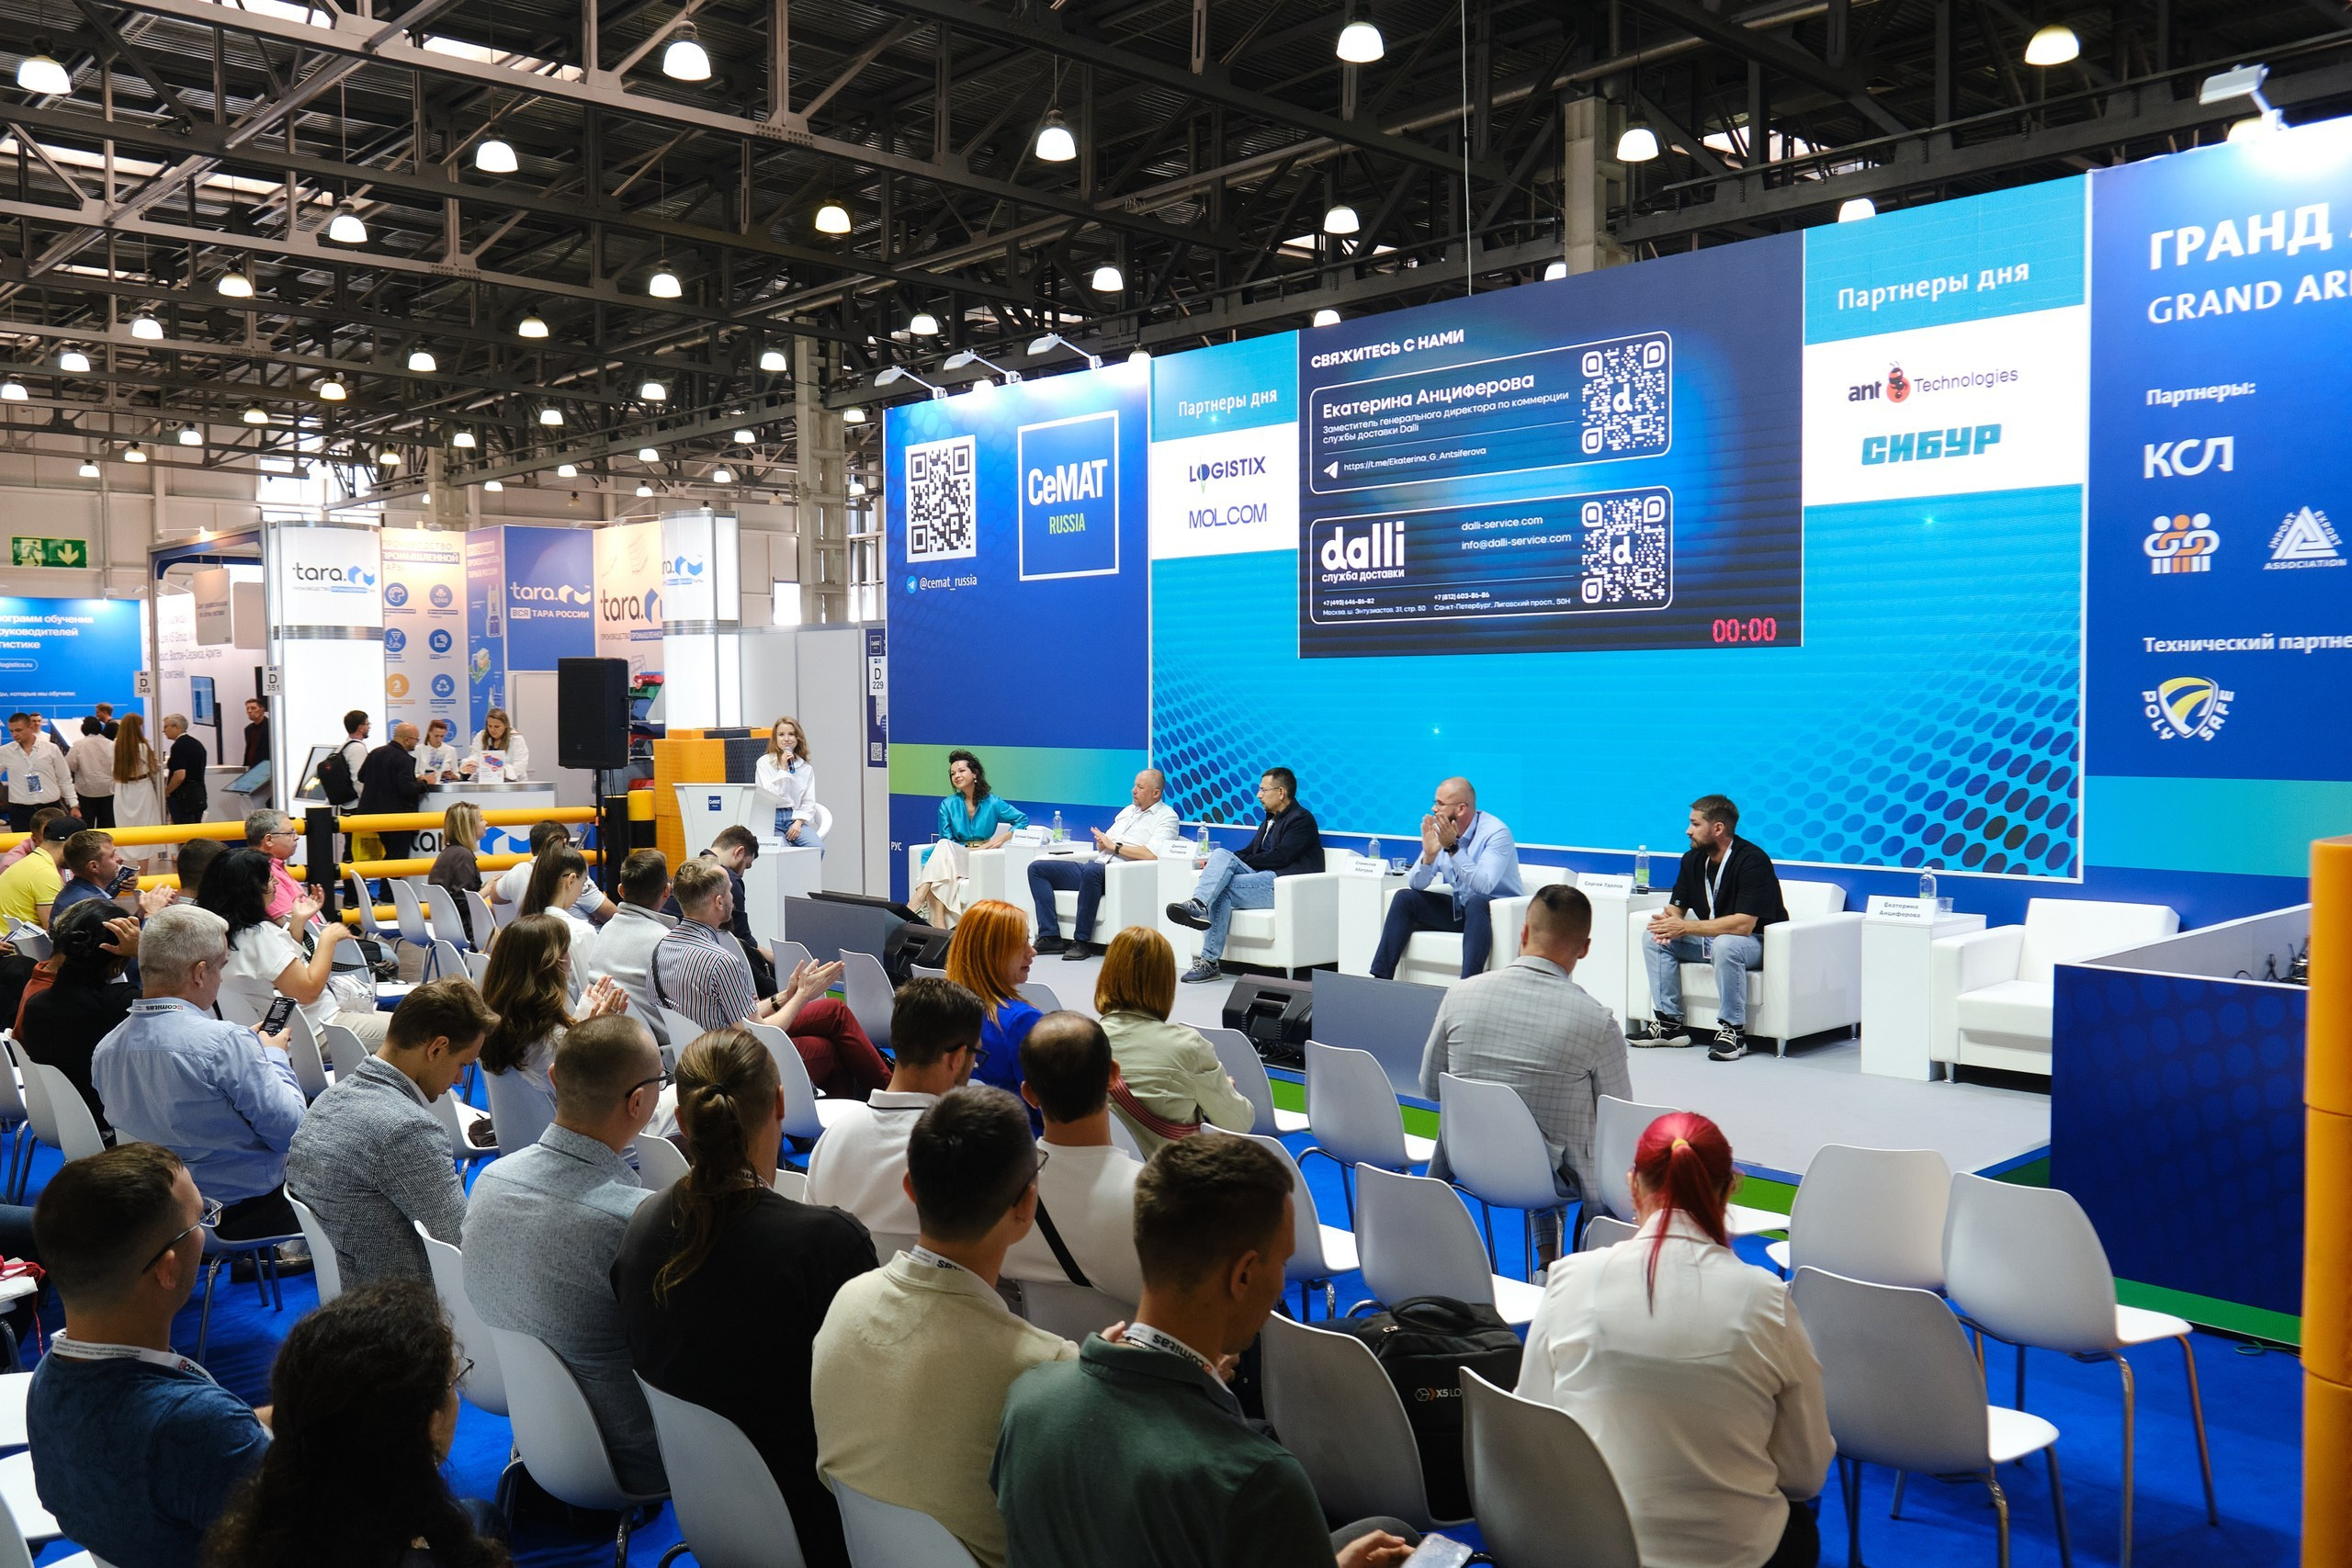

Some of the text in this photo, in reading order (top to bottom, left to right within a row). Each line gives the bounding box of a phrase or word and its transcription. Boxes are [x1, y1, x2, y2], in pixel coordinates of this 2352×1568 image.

[2150, 201, 2334, 270] ГРАНД
[1838, 263, 2030, 311] Партнеры дня
[2148, 270, 2352, 323] GRAND AR
[1311, 329, 1464, 368] СВЯЖИТЕСЬ С НАМИ
[1849, 368, 2018, 401] ant Technologies
[2146, 382, 2256, 407] Партнеры:
[1179, 389, 1278, 419] Партнеры дня
[1323, 374, 1534, 419] Екатерина Анциферова
[1323, 391, 1569, 434] Заместитель генерального директора по коммерции
[1323, 423, 1419, 444] службы доставки Dalli
[1861, 423, 2002, 466] СИБУР
[1190, 457, 1266, 482] LOGISTIX
[1344, 447, 1487, 471] https://t.me/Ekaterina_G_Antsiferova
[1028, 458, 1108, 505] CeMAT
[1049, 513, 1086, 535] RUSSIA
[1462, 516, 1544, 531] dalli-service.com
[2267, 512, 2296, 549] IMPORT
[2313, 510, 2343, 546] EXPORT
[1321, 521, 1405, 571] dalli
[1462, 534, 1572, 550] info@dalli-service.com
[2263, 558, 2346, 570] ASSOCIATION
[920, 574, 978, 591] @cemat_russia
[1322, 569, 1405, 583] служба доставки
[1456, 592, 1490, 600] 603-86-86
[1494, 599, 1530, 608] Лиговский
[0, 615, 95, 624] ограмм обучения
[512, 609, 590, 619] ВСЯ ТАРА РОССИИ
[1713, 617, 1777, 642] 00:00
[2143, 633, 2276, 652] Технический
[140, 679, 148, 687] D
[269, 674, 277, 684] D
[872, 681, 884, 690] 229
[875, 668, 882, 681] D
[2142, 690, 2176, 740] POLY
[2197, 689, 2235, 742] SAFE
[891, 840, 902, 852] РУС
[1879, 909, 1921, 919] Анциферова
[1436, 1388, 1449, 1398] X5
